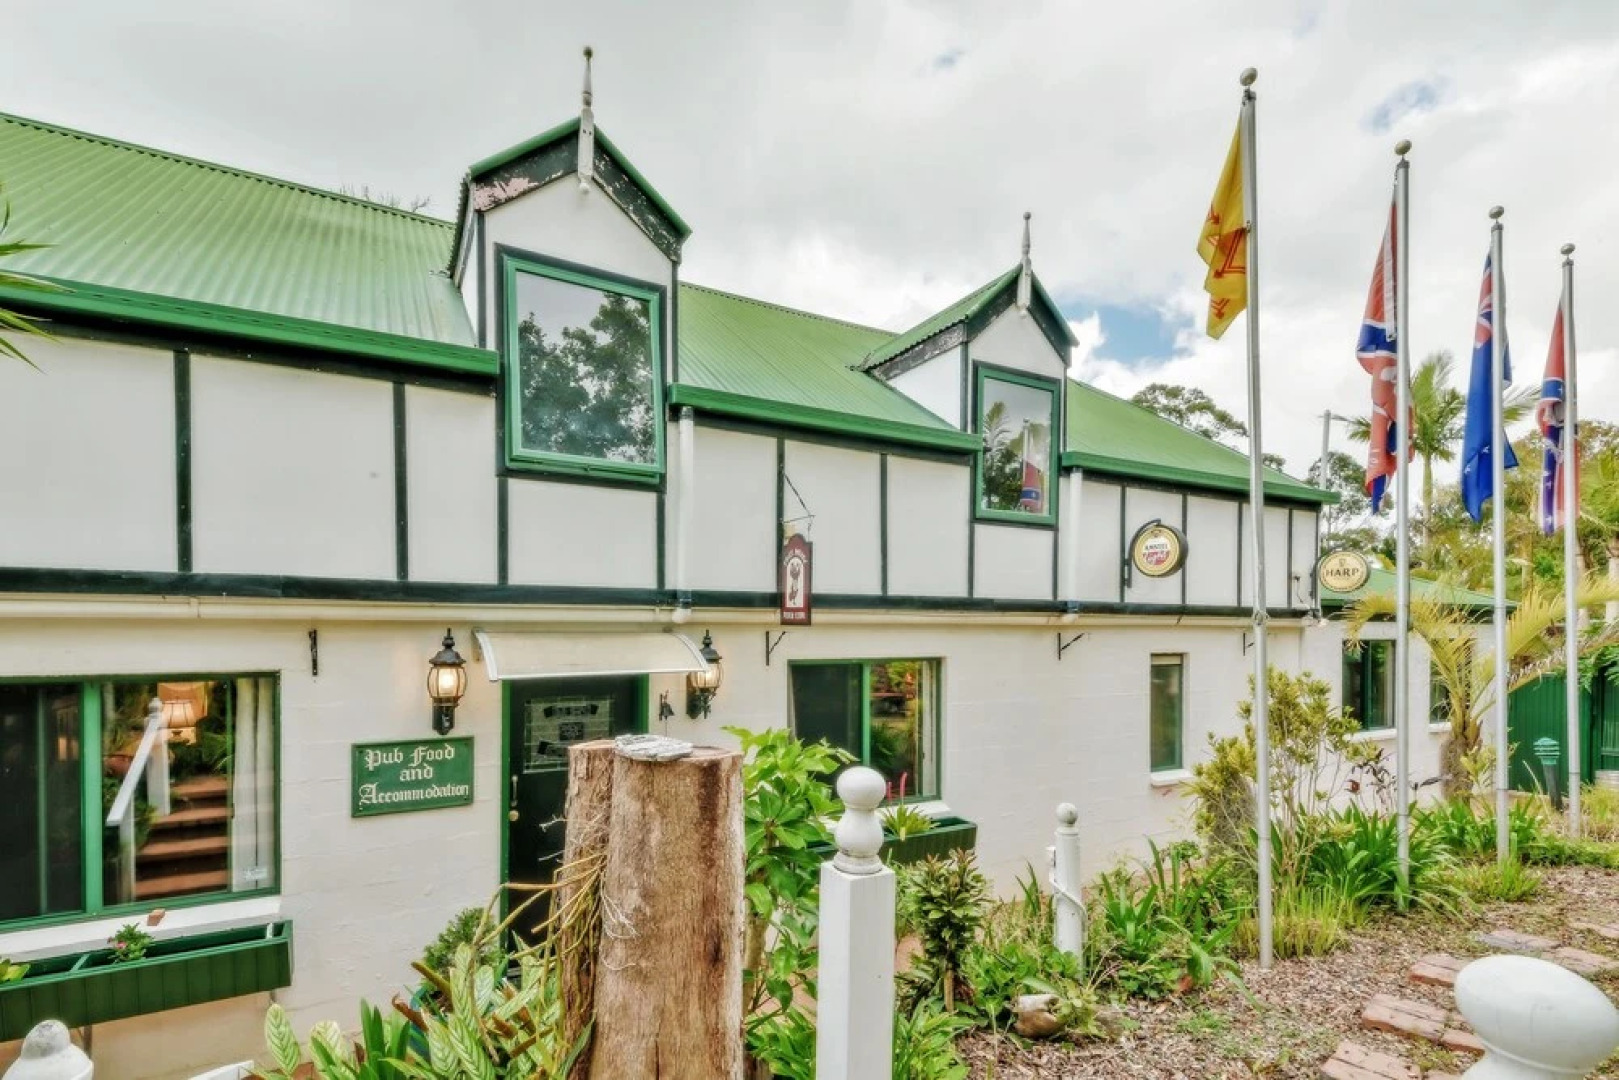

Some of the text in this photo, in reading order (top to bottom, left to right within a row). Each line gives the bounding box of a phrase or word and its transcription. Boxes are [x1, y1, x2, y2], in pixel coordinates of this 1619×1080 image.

[1326, 567, 1359, 577] HARP
[364, 743, 456, 771] Pub Food
[400, 763, 433, 781] and
[359, 782, 469, 806] Accommodation
